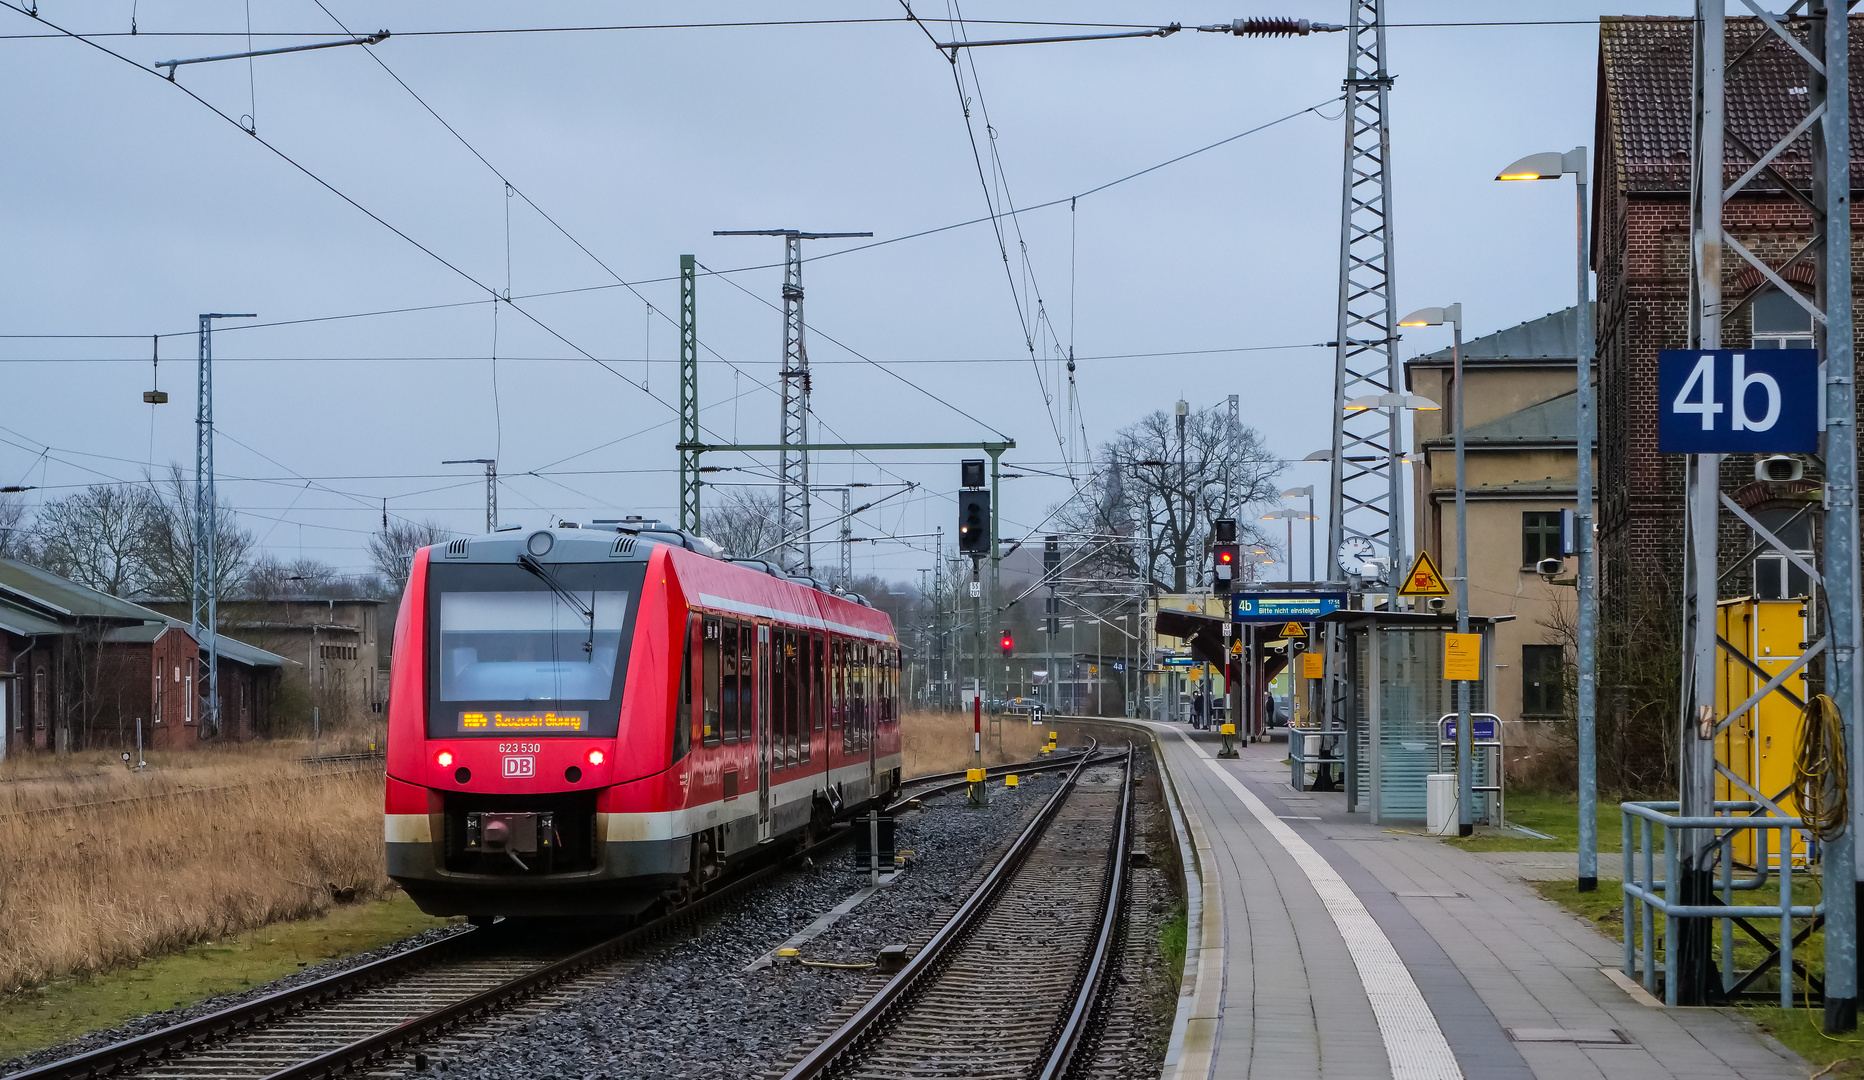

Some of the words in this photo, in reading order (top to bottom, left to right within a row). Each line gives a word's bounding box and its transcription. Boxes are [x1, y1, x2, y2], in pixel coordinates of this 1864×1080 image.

[1673, 354, 1782, 432] 4b
[1238, 600, 1252, 611] 4b
[1290, 607, 1321, 615] einsteigen
[1113, 662, 1123, 670] 4a
[1032, 686, 1038, 694] H
[463, 713, 488, 727] RE4
[1033, 710, 1042, 721] H
[499, 743, 518, 753] 623
[521, 743, 541, 753] 530
[506, 758, 531, 774] DB
